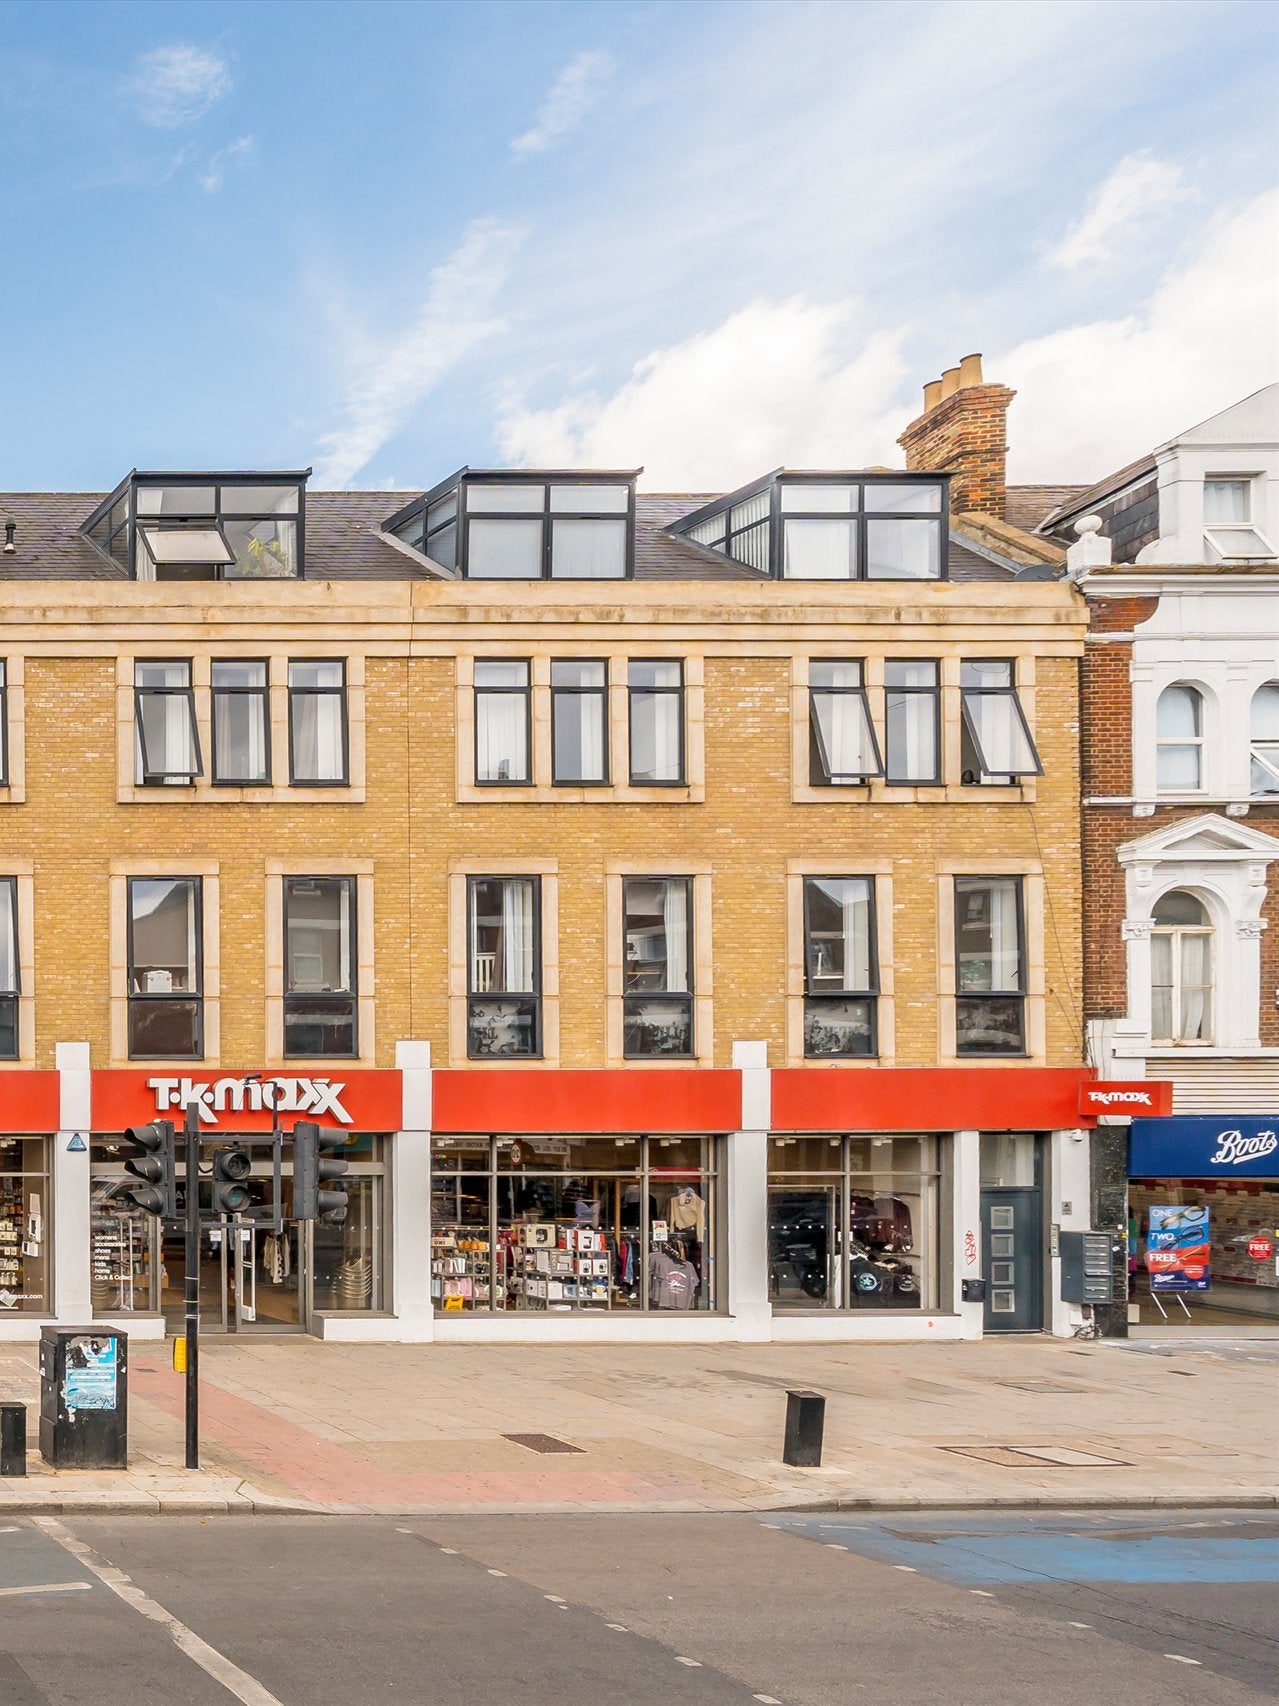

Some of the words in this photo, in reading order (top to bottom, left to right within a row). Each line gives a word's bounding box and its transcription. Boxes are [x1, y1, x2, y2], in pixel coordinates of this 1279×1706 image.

[1210, 1130, 1278, 1164] Boots
[1152, 1209, 1173, 1217] ONE
[1250, 1243, 1270, 1251] FREE
